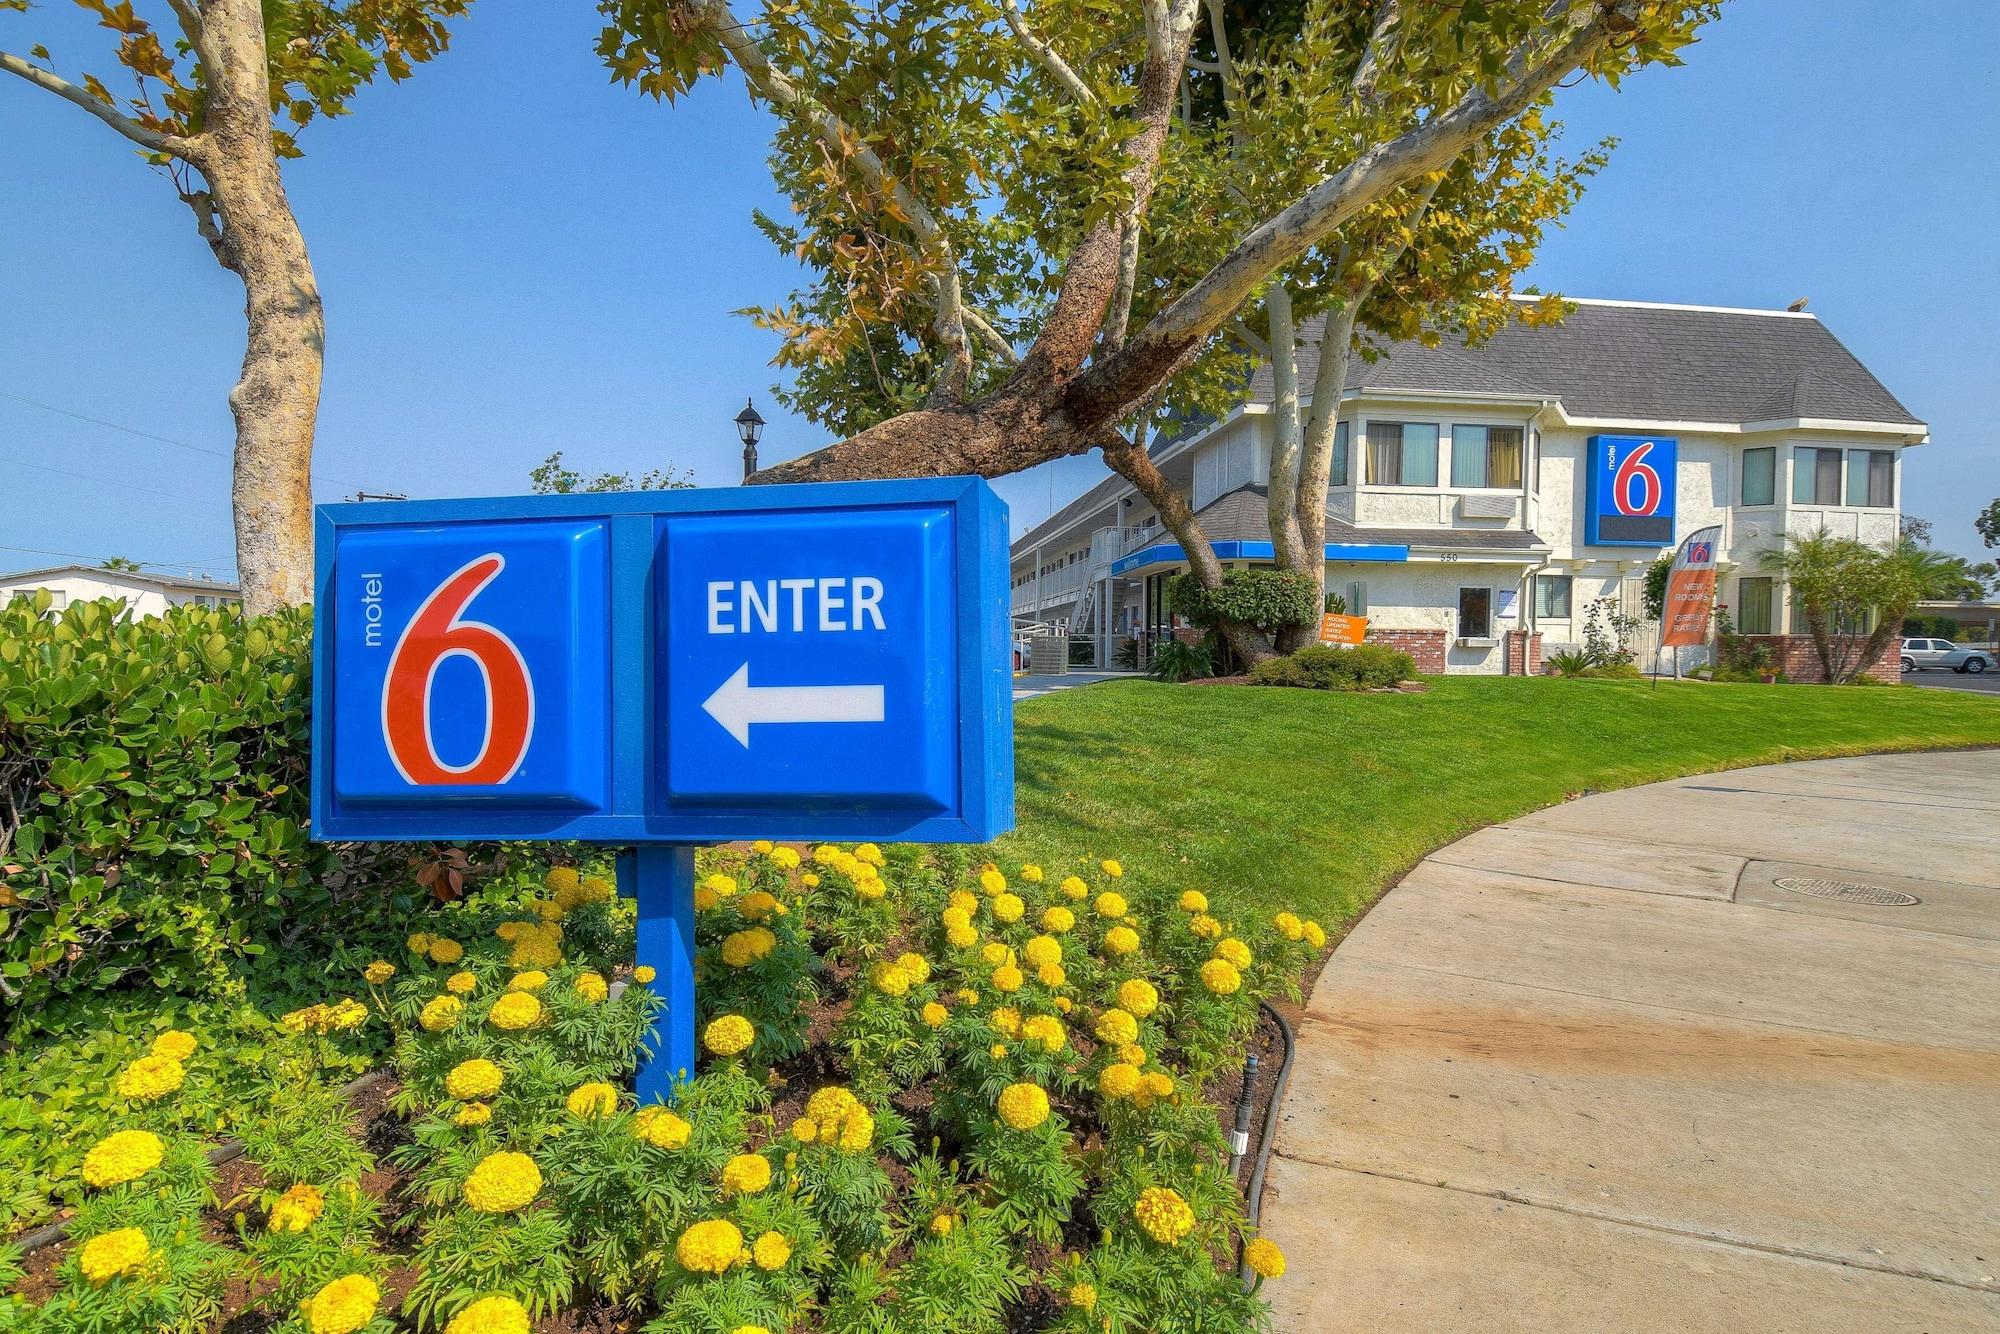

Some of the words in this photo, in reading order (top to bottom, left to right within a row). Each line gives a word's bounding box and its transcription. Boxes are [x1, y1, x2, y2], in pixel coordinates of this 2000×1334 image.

[1607, 445, 1616, 470] motel
[1613, 442, 1662, 516] 6
[1690, 543, 1709, 564] 6
[707, 576, 887, 634] ENTER
[361, 573, 382, 647] motel
[381, 552, 536, 786] 6
